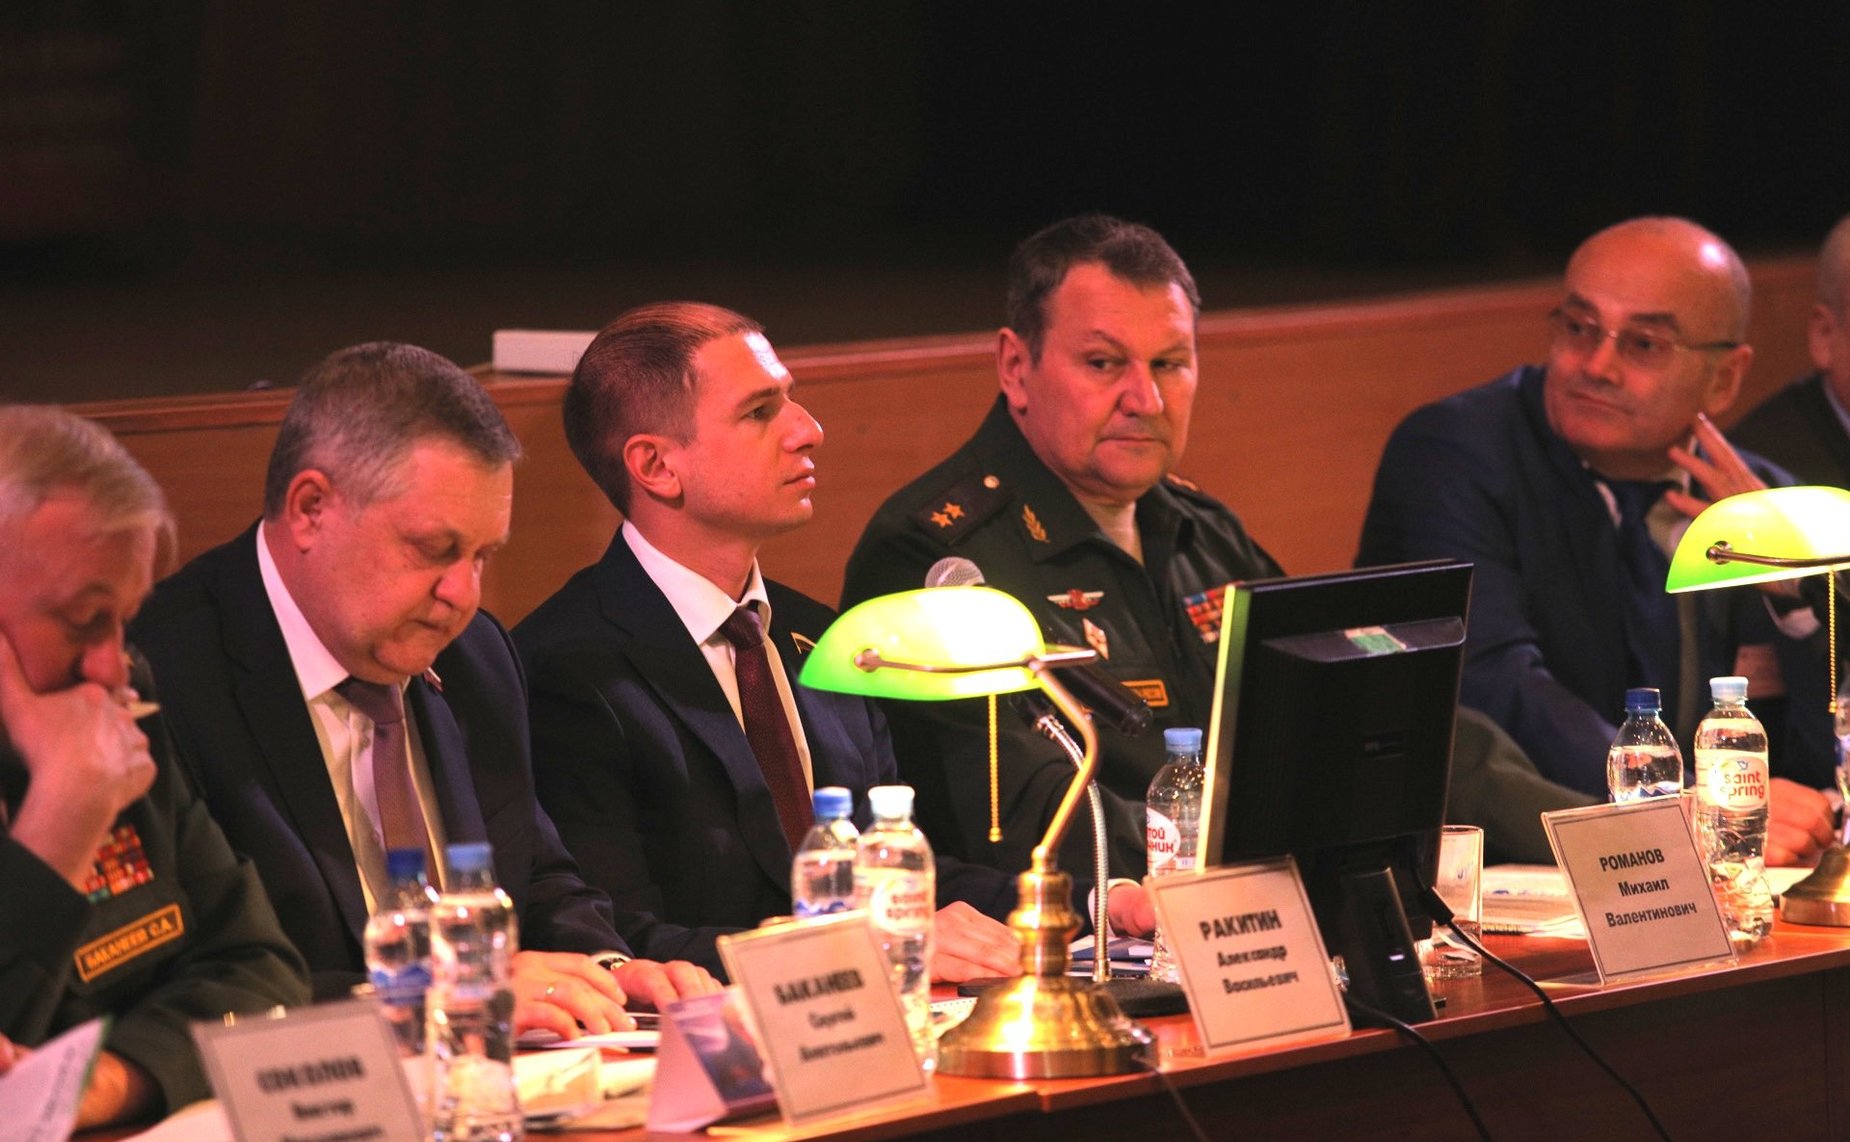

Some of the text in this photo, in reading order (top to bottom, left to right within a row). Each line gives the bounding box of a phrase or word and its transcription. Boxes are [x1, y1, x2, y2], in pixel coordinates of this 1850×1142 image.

[1723, 771, 1762, 785] saint
[1598, 848, 1666, 873] РОМАНОВ
[1617, 878, 1671, 898] Михаил
[1198, 908, 1283, 942] РАКИТИН
[1604, 902, 1698, 928] Валентинович
[1216, 944, 1288, 969] Александр
[1222, 970, 1300, 995] Васильевич
